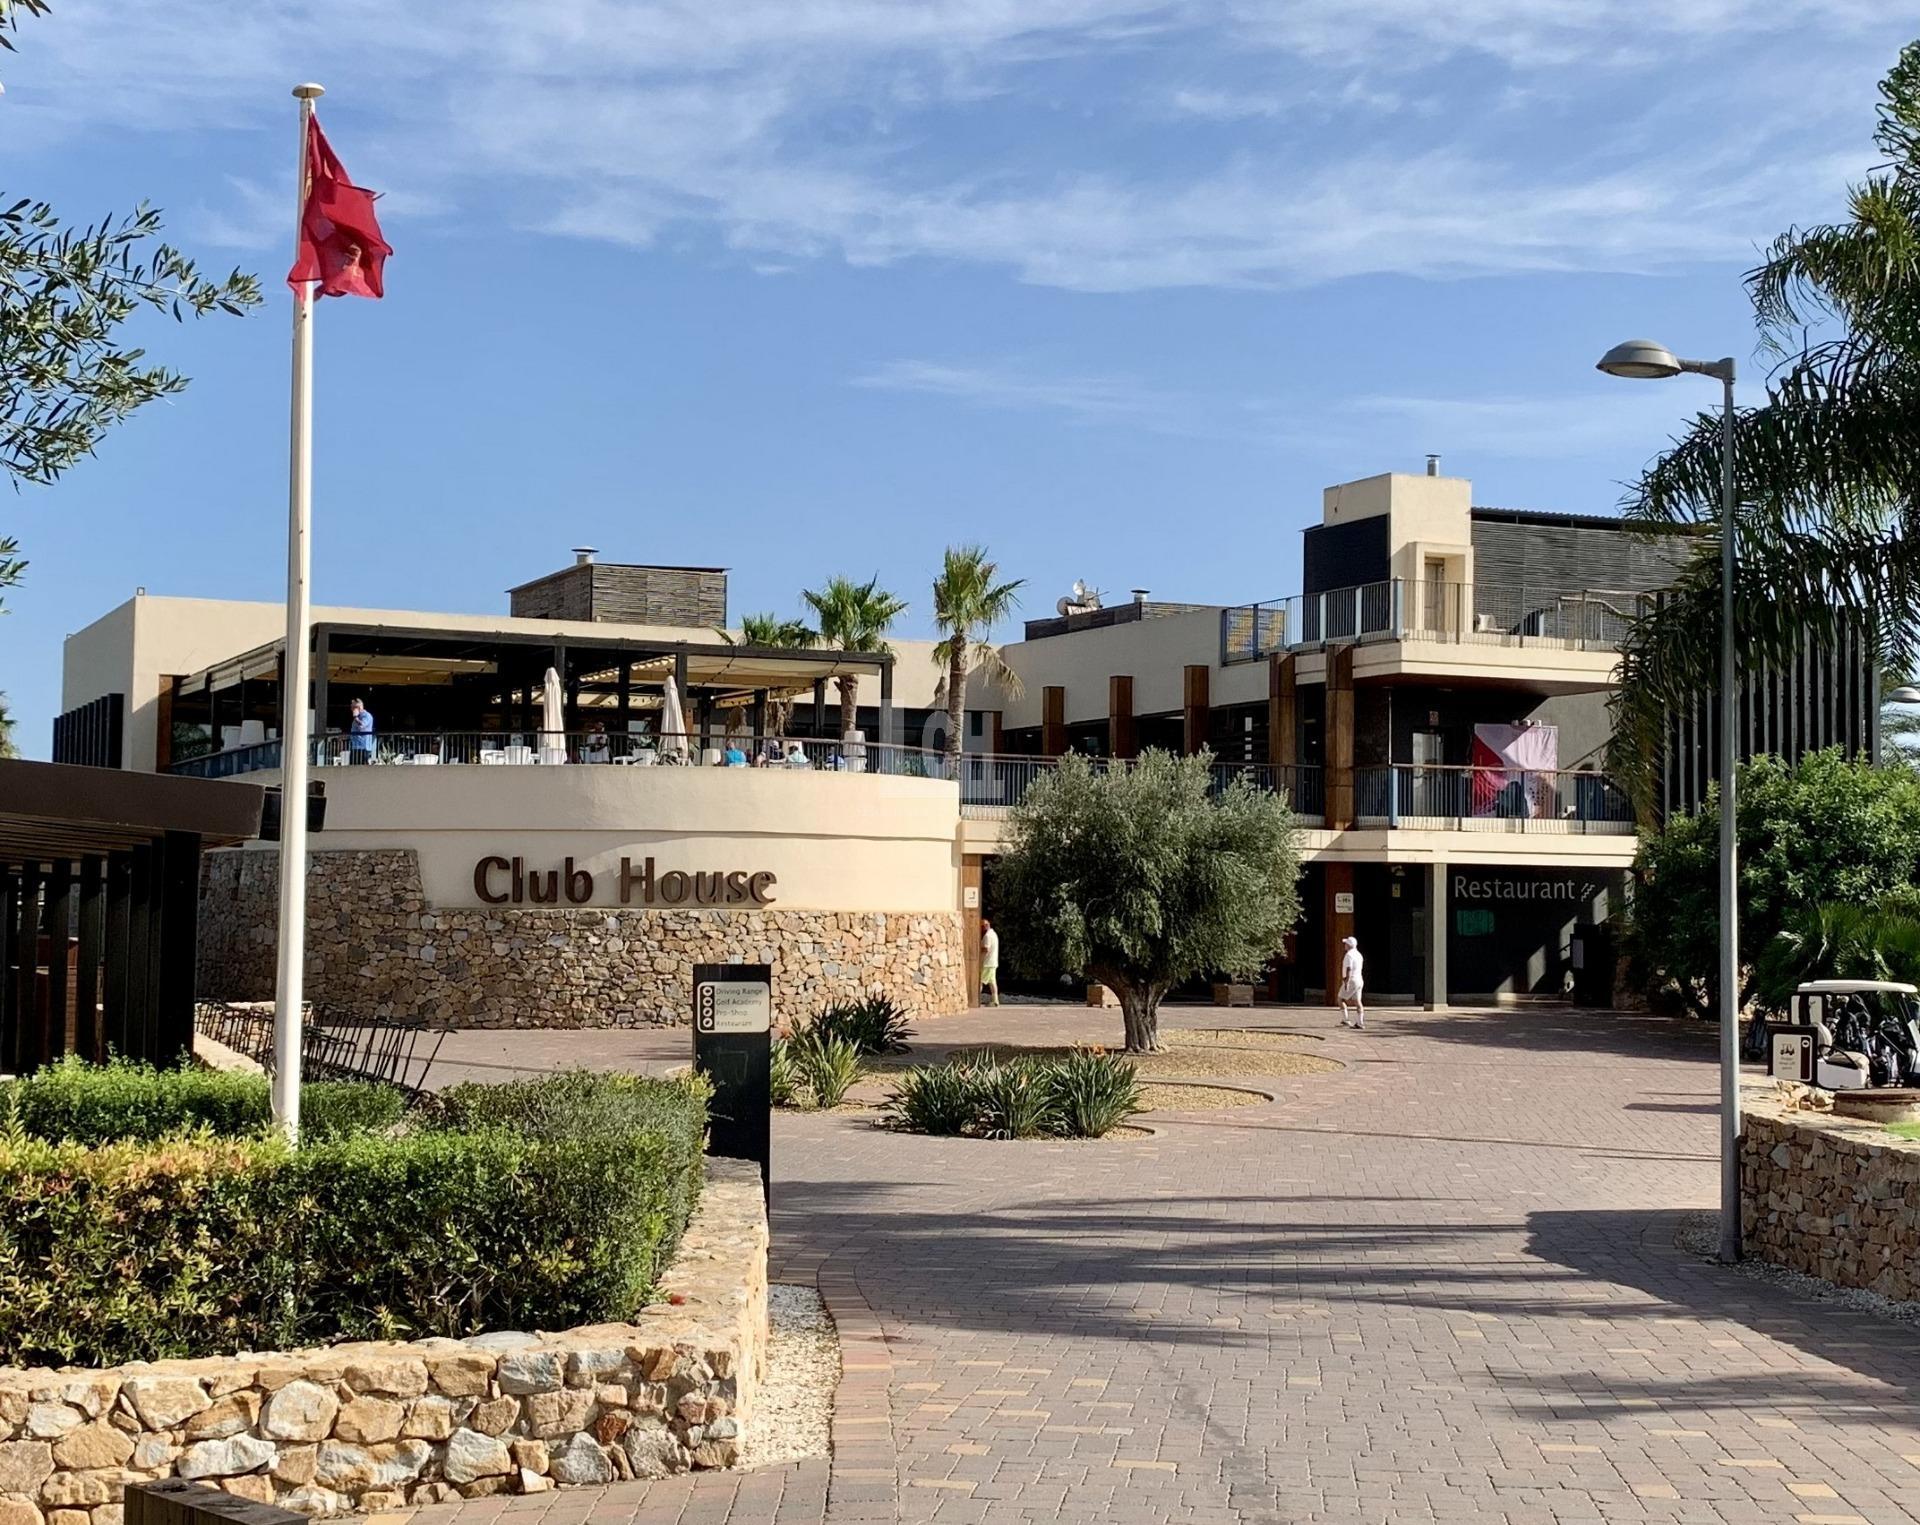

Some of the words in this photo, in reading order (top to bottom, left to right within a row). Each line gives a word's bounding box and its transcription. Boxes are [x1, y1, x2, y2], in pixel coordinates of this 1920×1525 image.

[474, 856, 593, 904] Club
[620, 856, 777, 904] House
[1454, 875, 1576, 900] Restaurant
[716, 988, 741, 996] Driving
[742, 988, 763, 996] Range
[716, 998, 730, 1006] Golf
[732, 998, 762, 1007] Academy
